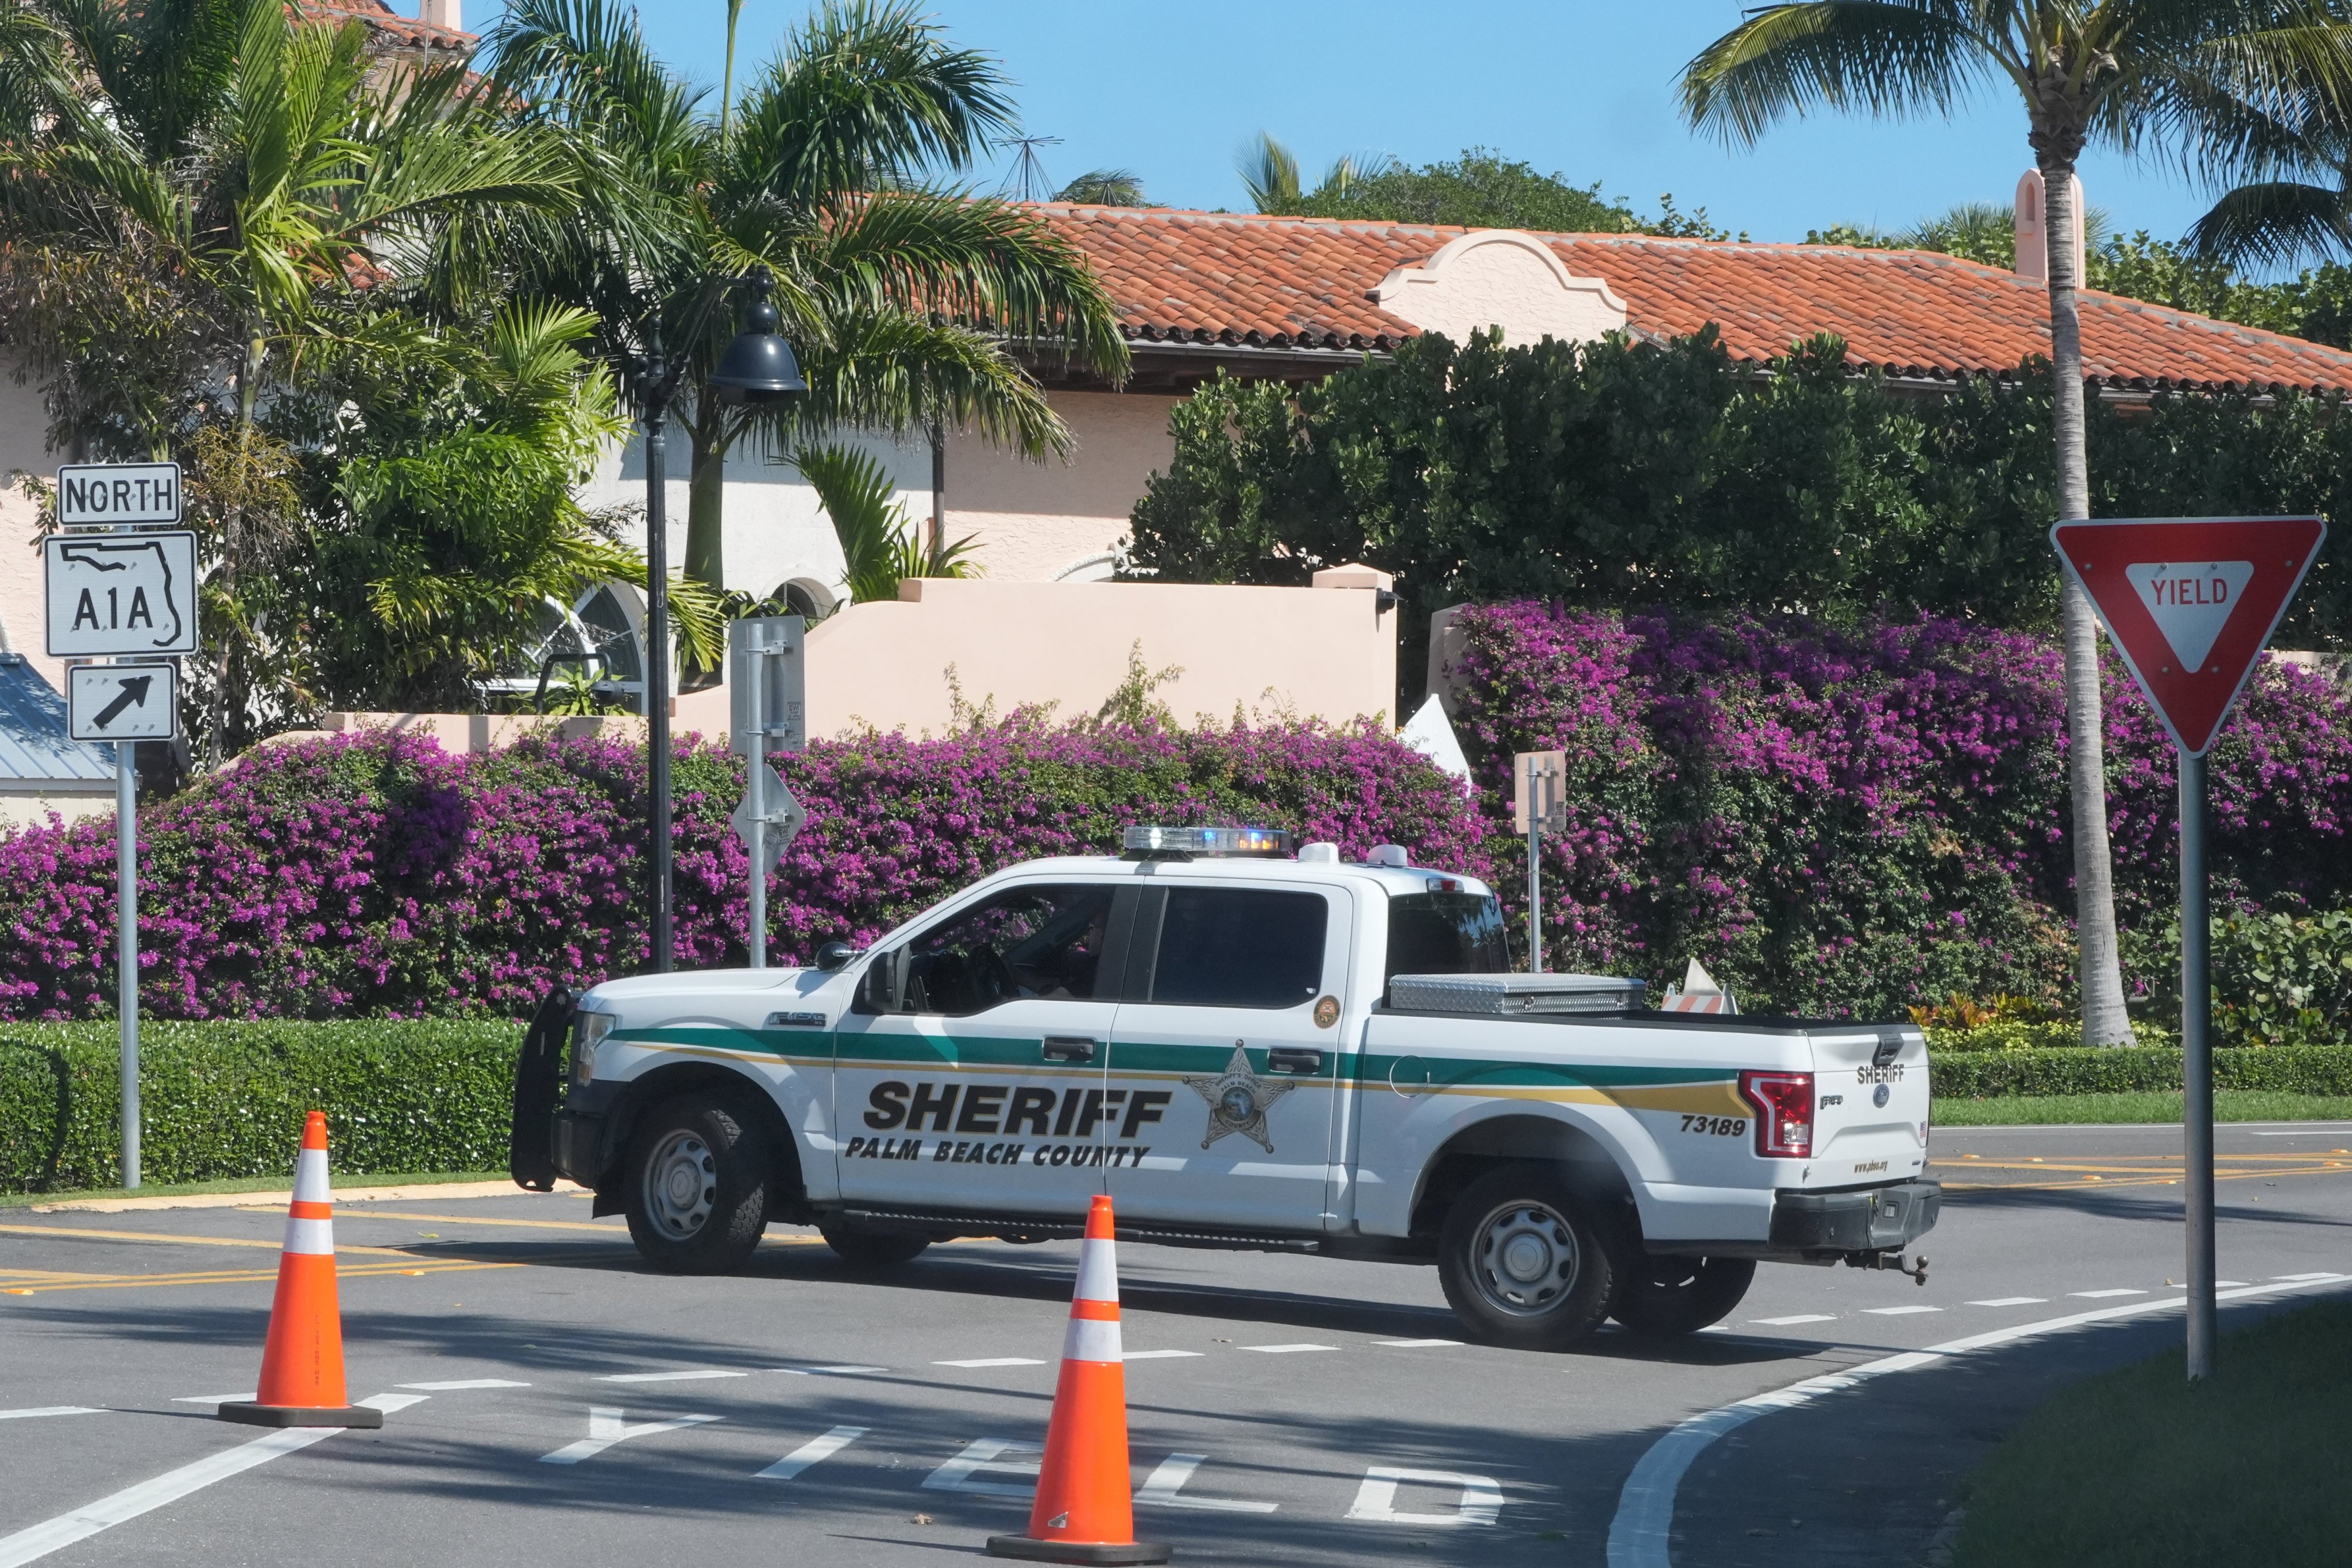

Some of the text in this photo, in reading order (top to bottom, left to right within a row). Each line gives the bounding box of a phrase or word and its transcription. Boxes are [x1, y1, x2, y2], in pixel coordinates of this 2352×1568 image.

[66, 478, 172, 513] NORTH
[2151, 578, 2227, 605] YIELD
[74, 586, 153, 630] A1A
[1215, 1073, 1261, 1089] SHERIFF'S OFFICE
[1857, 1064, 1904, 1084] SHERIFF
[1221, 1082, 1256, 1094] PALM BEACH
[863, 1080, 1174, 1139] SHERIFF
[1681, 1114, 1746, 1137] 73189
[844, 1137, 1151, 1168] PALM BEACH COUNTY
[1855, 1159, 1888, 1174] www.pbso.org
[536, 1407, 1505, 1525] YIELD
